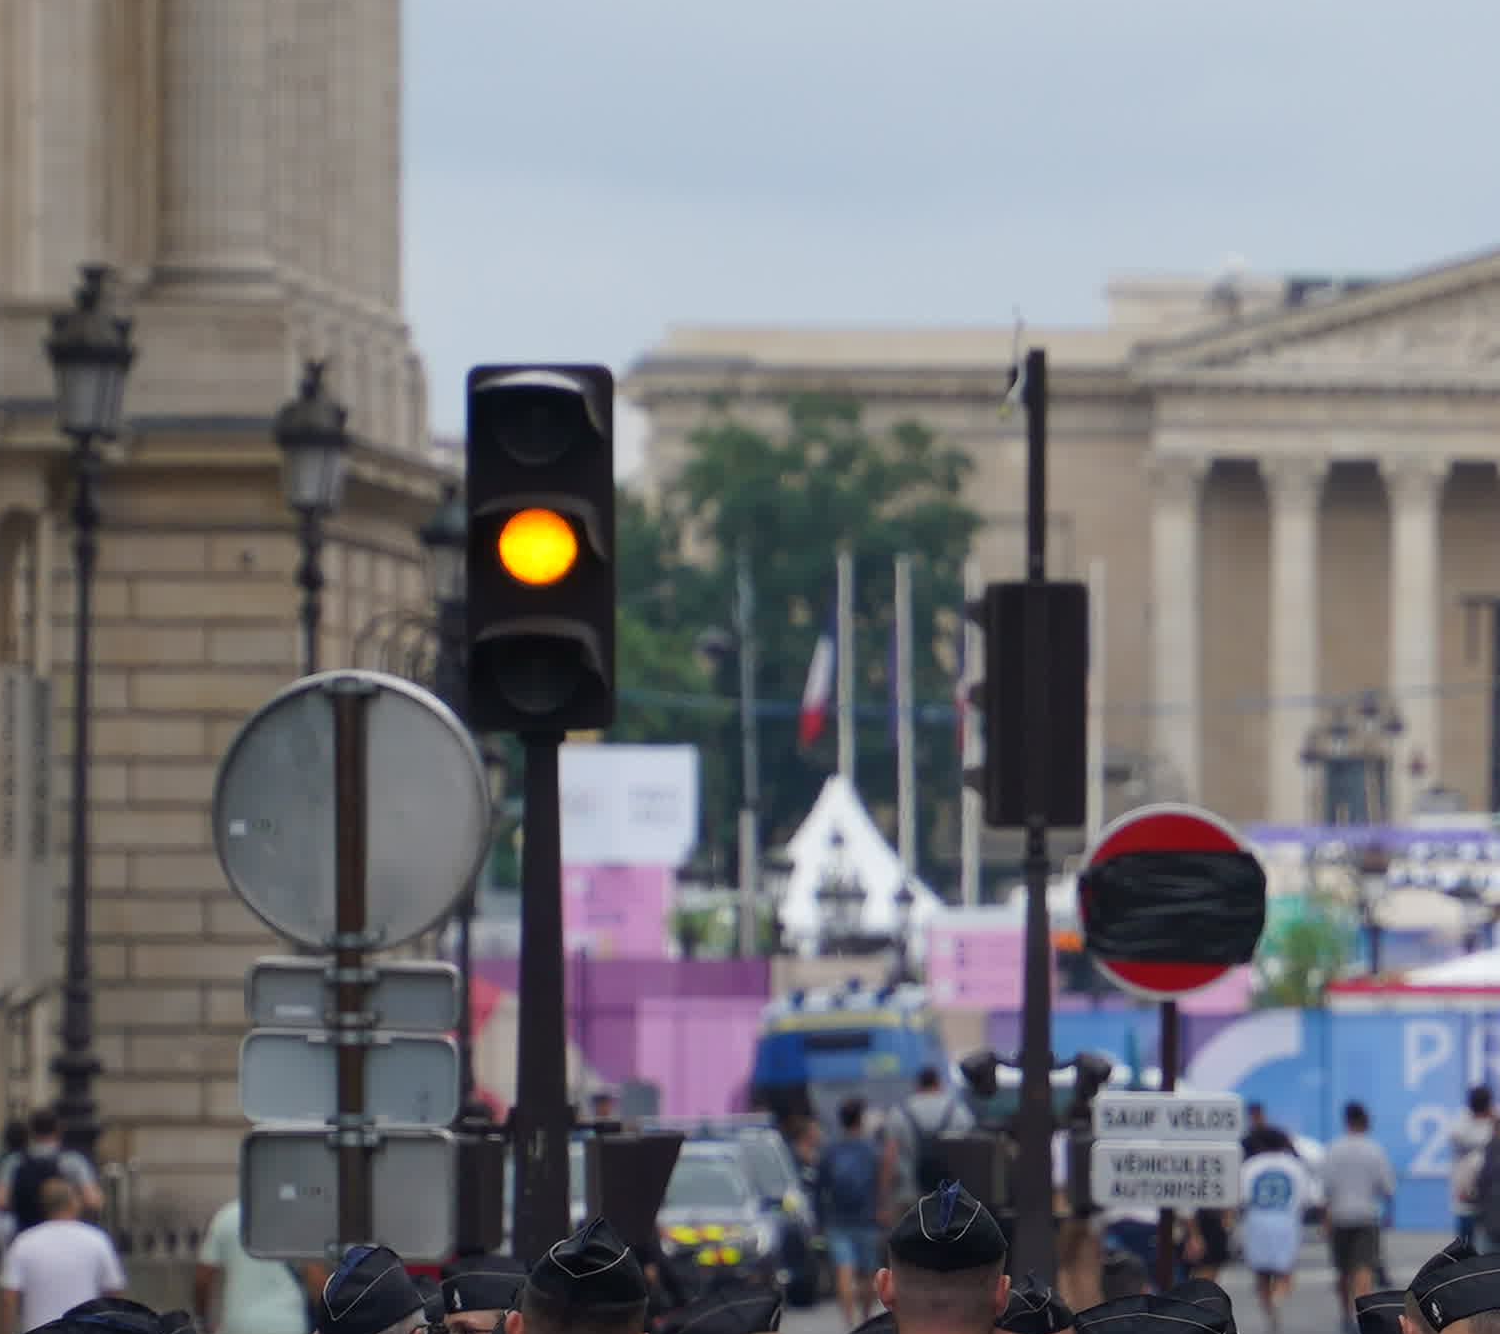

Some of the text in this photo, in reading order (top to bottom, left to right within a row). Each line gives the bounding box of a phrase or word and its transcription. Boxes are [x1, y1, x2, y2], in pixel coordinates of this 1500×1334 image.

[1104, 1099, 1236, 1130] SAUF VÉLOS
[1111, 1150, 1224, 1174] VÉHICULES
[1110, 1178, 1224, 1200] AUTORISÉS
